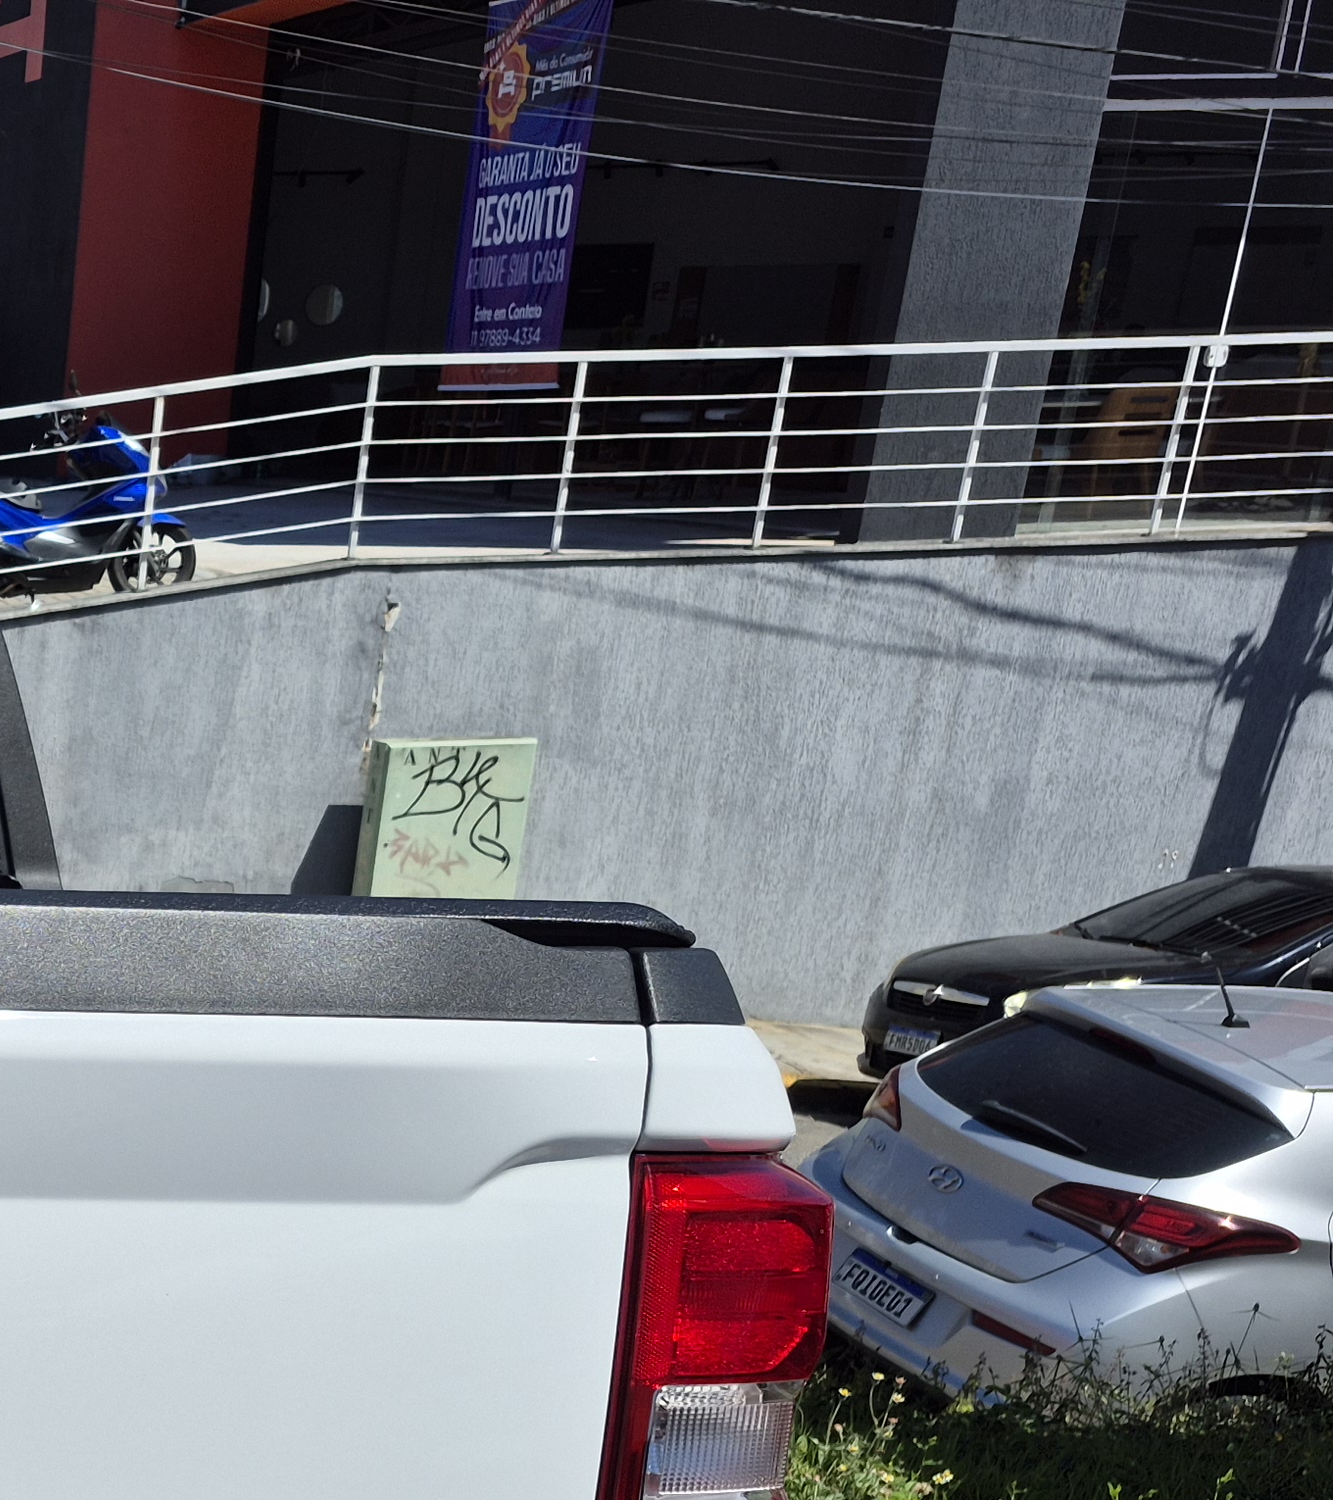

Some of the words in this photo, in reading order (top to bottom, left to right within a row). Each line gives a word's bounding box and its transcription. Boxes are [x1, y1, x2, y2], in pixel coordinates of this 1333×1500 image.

[479, 151, 530, 188] GARANTA
[472, 184, 574, 248] DESCONTO
[508, 253, 529, 285] SUA
[532, 248, 566, 285] CASA
